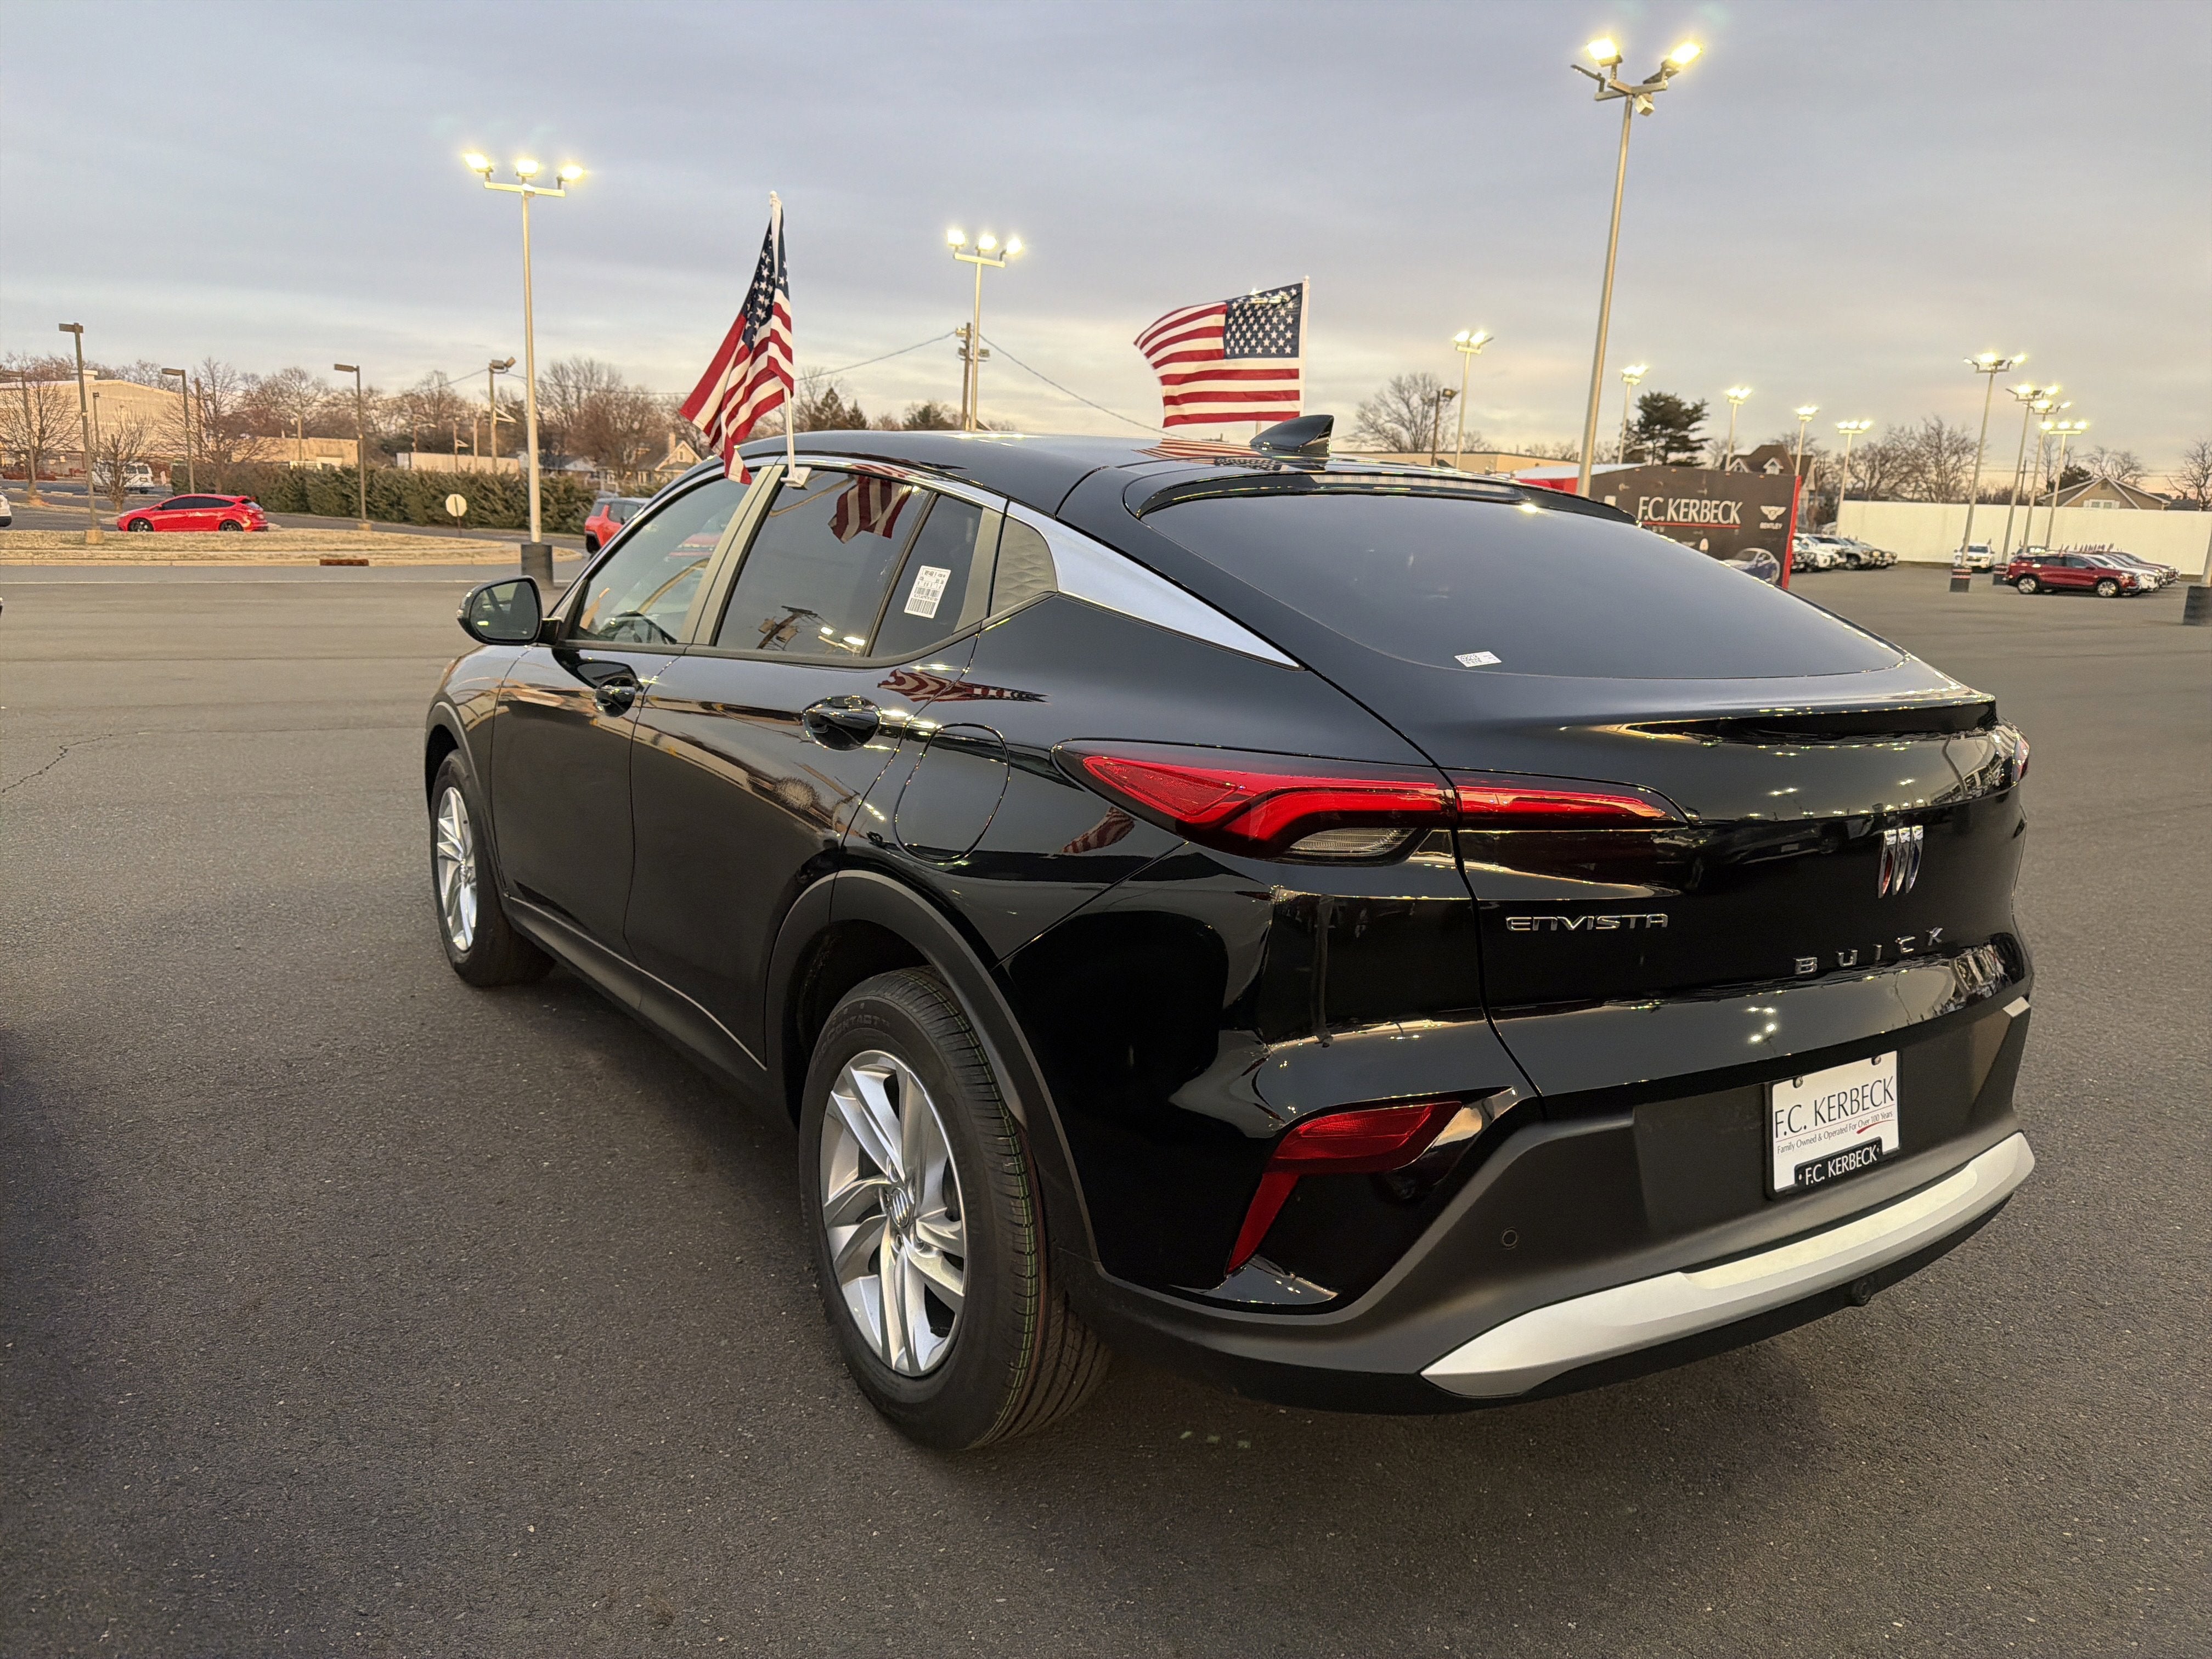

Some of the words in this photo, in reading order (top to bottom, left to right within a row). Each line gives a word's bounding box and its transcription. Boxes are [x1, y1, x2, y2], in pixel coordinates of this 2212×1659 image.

[1638, 496, 1665, 521] F.C.
[1667, 498, 1743, 524] KERBECK
[1506, 913, 1668, 931] ENVISTA
[1793, 927, 1943, 975] BUICK
[1775, 1104, 1807, 1138] F.C.
[1814, 1076, 1894, 1126] KERBECK
[1778, 1141, 1795, 1154] Family
[1796, 1134, 1816, 1148] Owned
[1824, 1124, 1848, 1140] Operated
[1849, 1123, 1857, 1132] For
[1858, 1119, 1870, 1127] Over
[1871, 1114, 1880, 1123] 100
[1881, 1111, 1893, 1119] Years
[1805, 1164, 1825, 1185] F.C.
[1828, 1144, 1877, 1178] KERBECK
